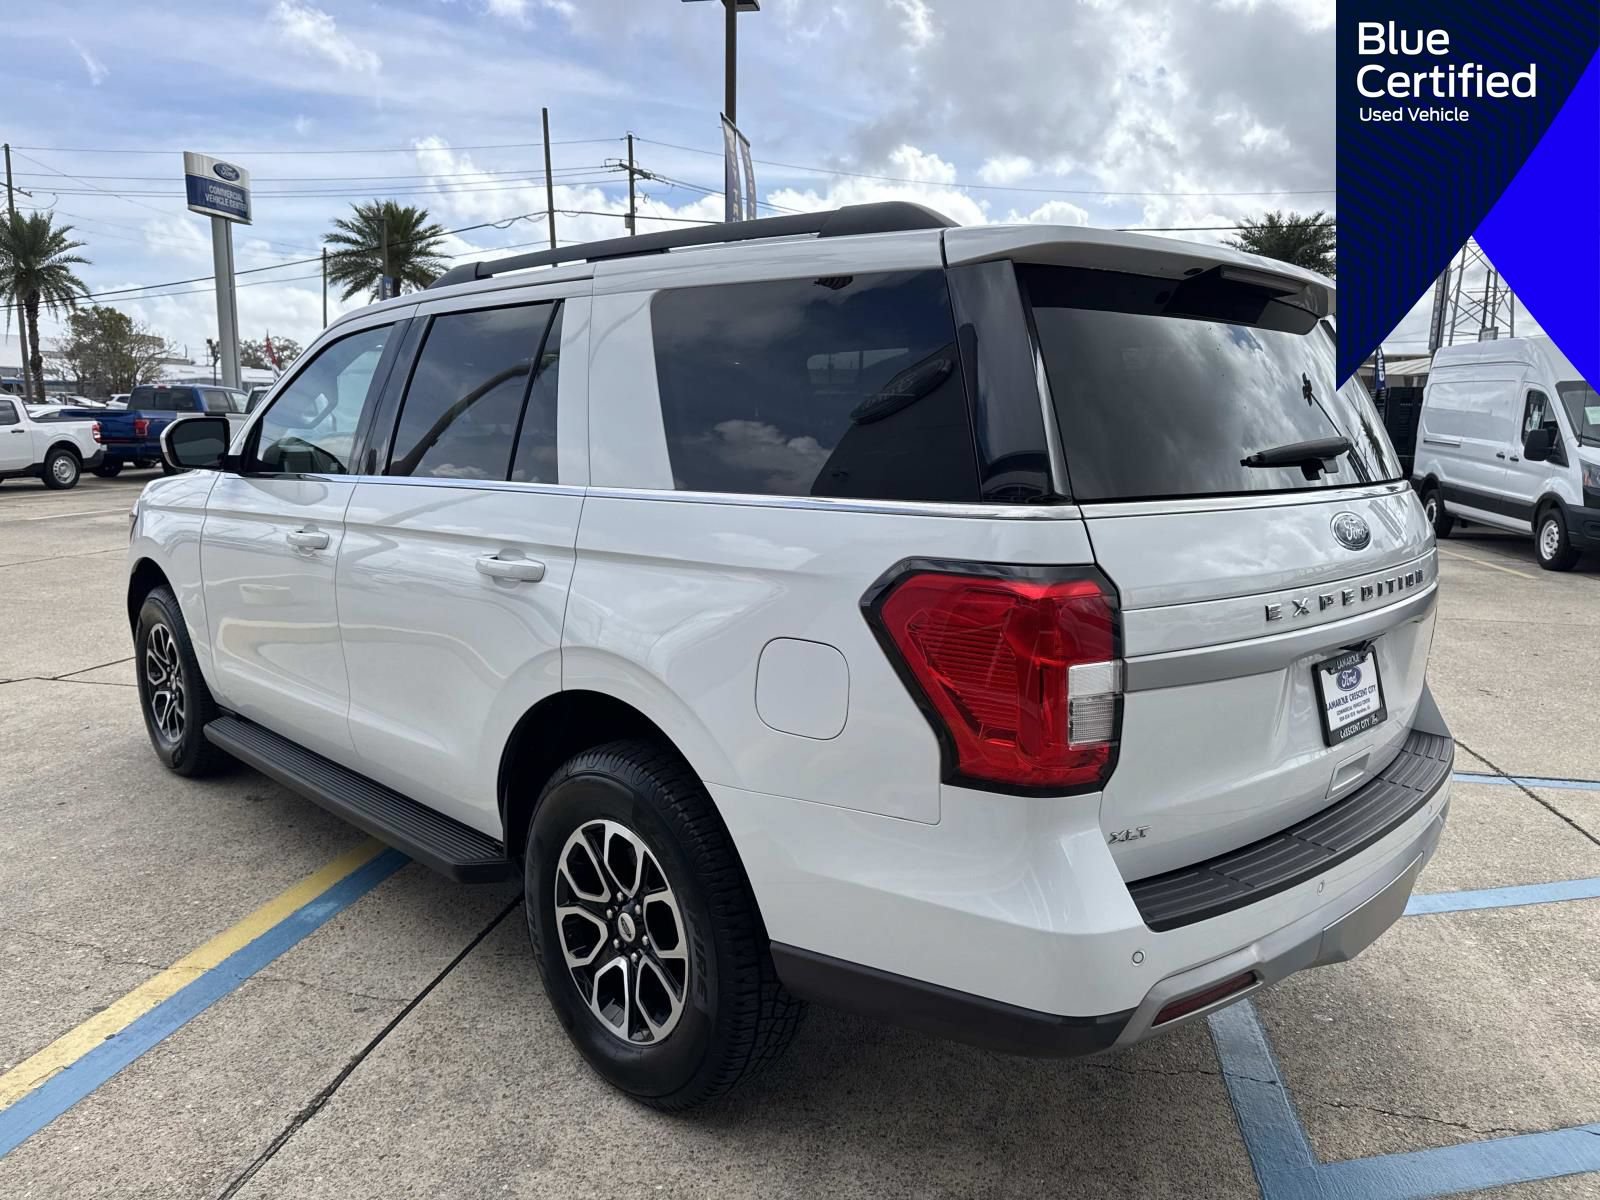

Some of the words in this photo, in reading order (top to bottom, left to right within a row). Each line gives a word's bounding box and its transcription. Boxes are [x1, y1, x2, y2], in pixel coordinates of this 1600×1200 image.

[1265, 569, 1424, 621] EXPEDITION
[1349, 687, 1368, 702] CRESCENT
[1368, 684, 1376, 694] CITY
[1340, 721, 1360, 739] CRESCENT
[1360, 717, 1370, 729] CITY
[1108, 824, 1152, 845] XLT
